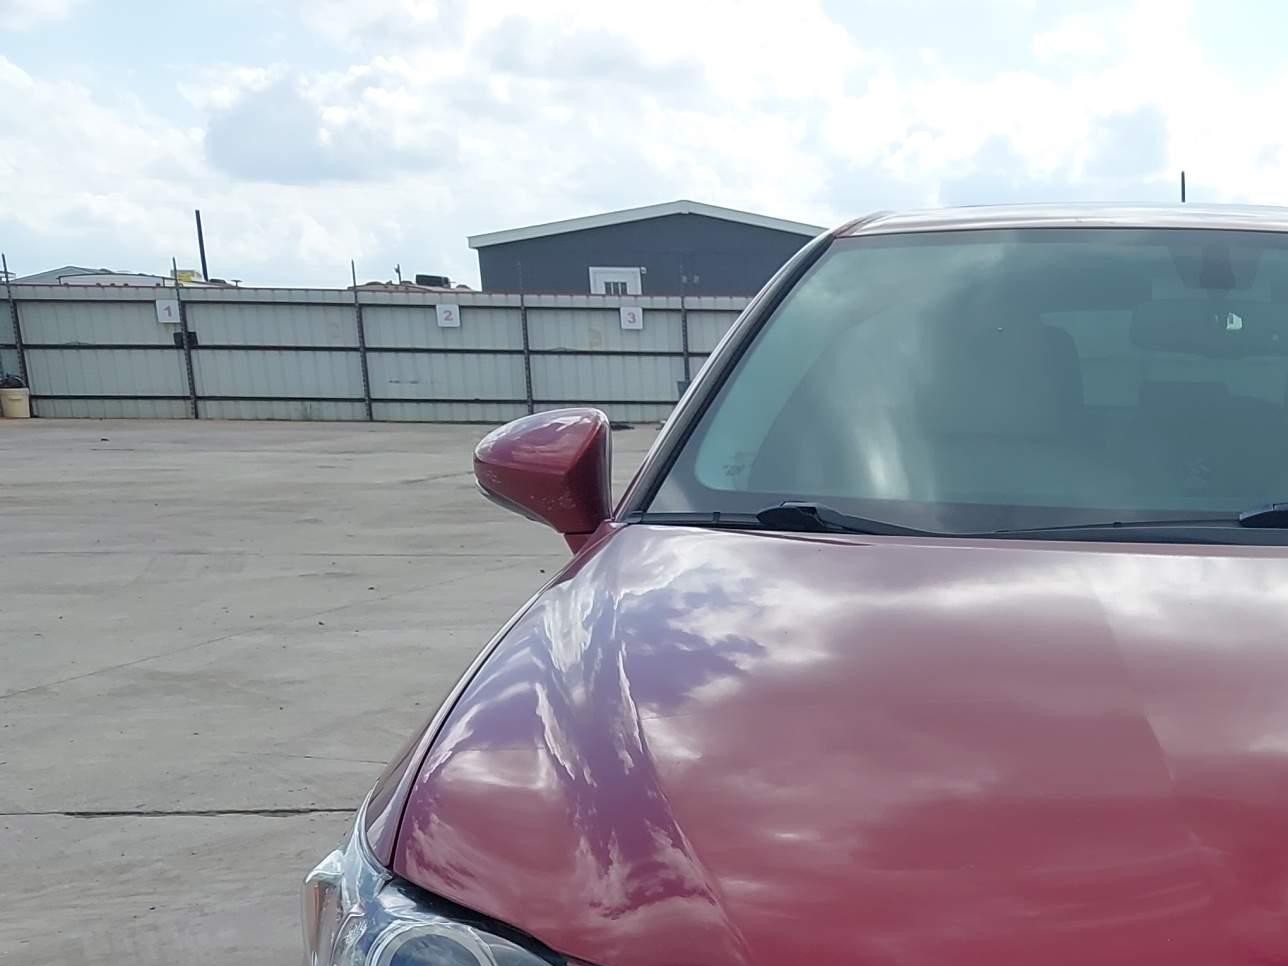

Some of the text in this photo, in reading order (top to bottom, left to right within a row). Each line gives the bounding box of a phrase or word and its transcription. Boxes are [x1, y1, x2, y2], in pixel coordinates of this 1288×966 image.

[163, 305, 172, 318] 1
[443, 310, 454, 321] 2
[627, 312, 637, 324] 3
